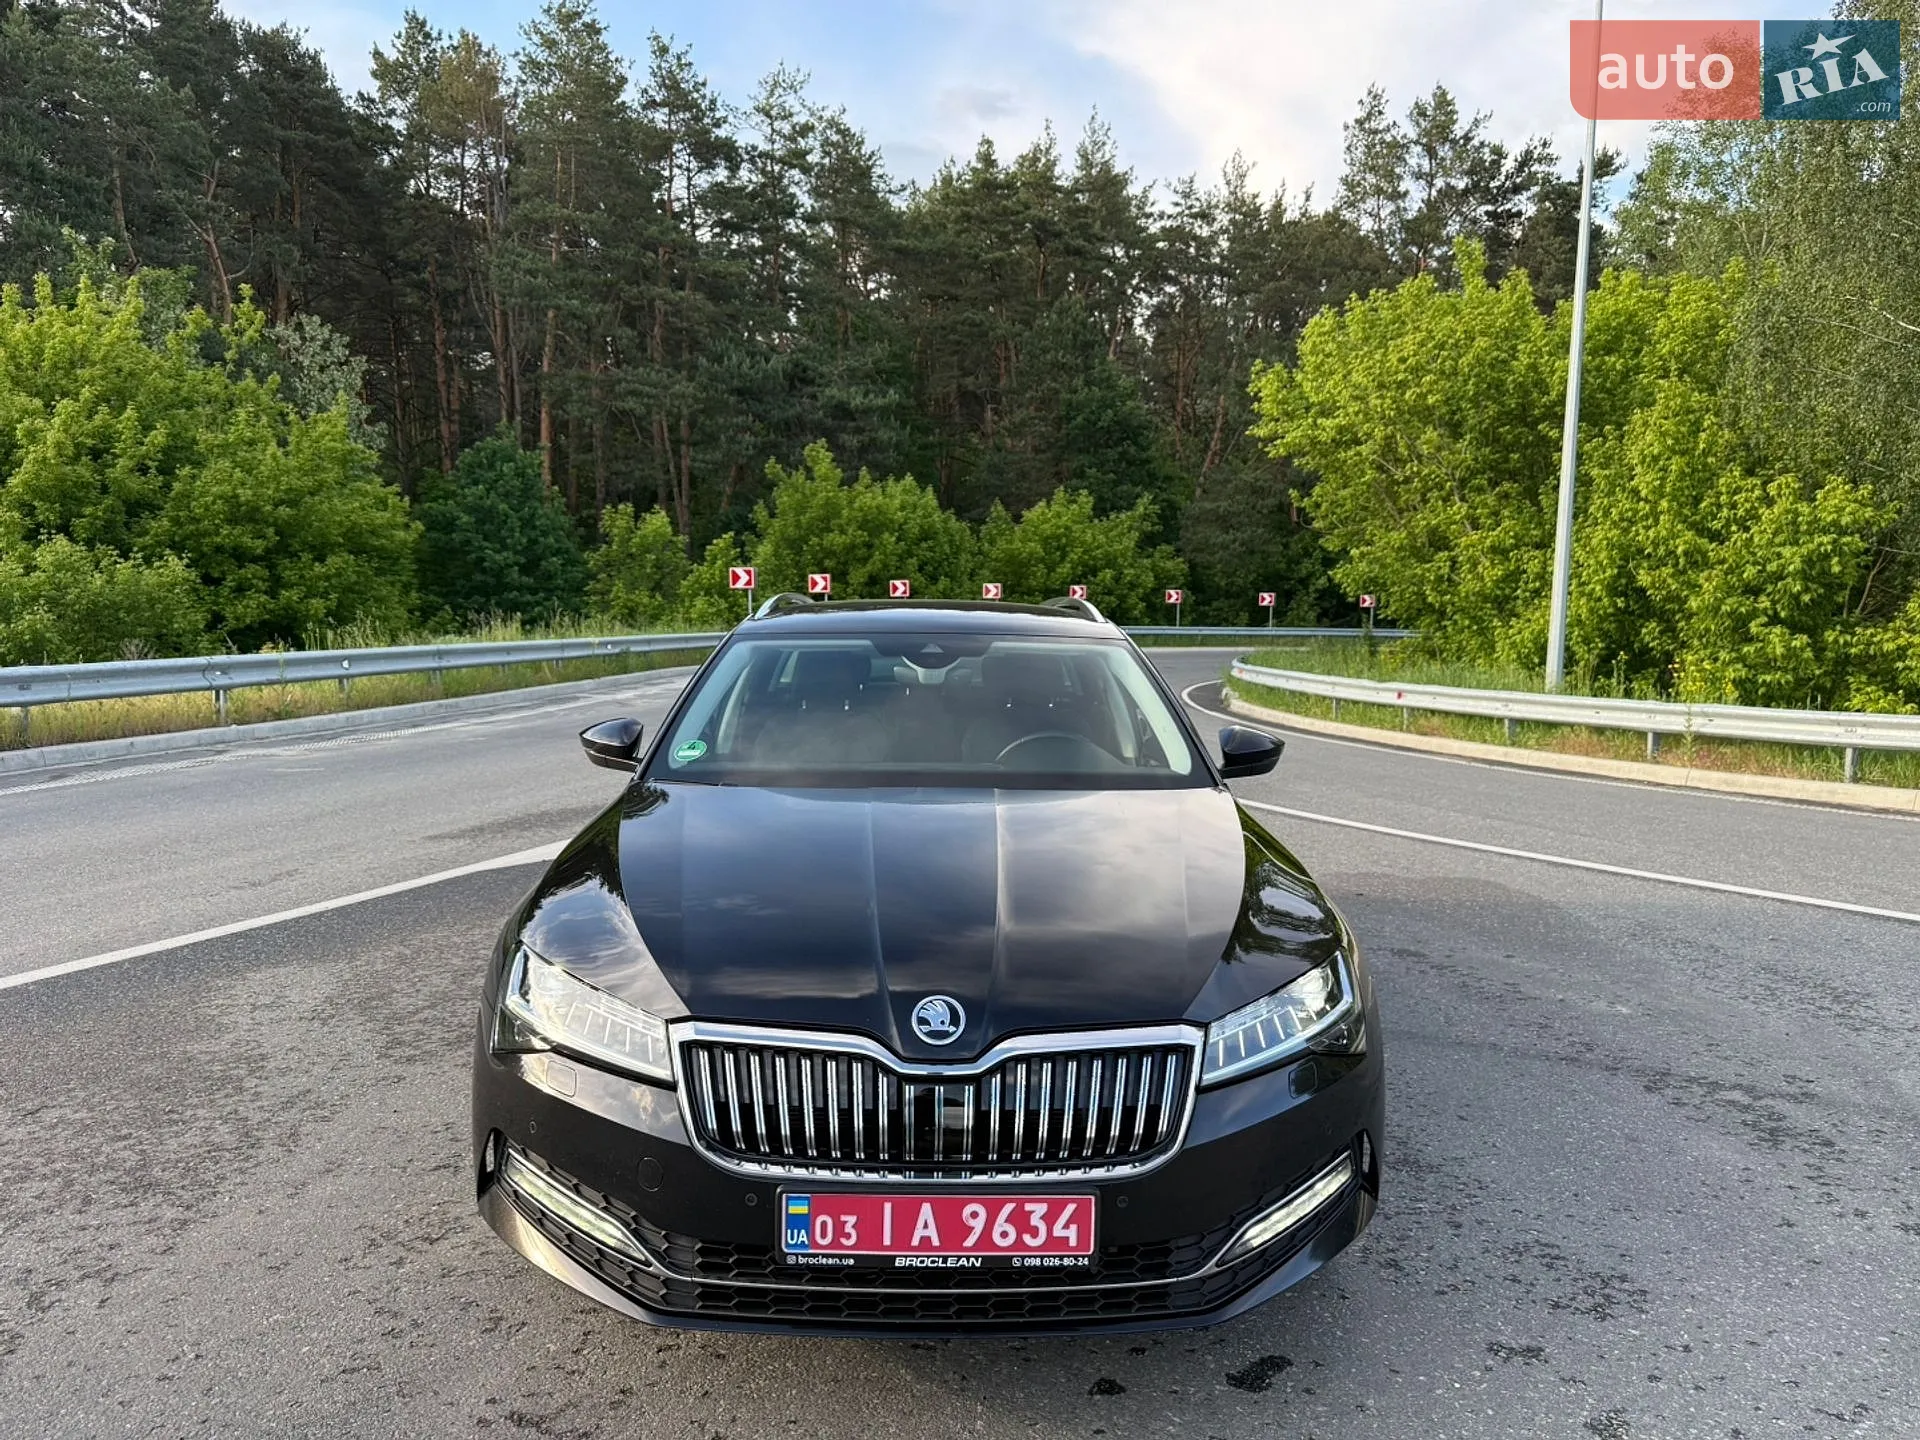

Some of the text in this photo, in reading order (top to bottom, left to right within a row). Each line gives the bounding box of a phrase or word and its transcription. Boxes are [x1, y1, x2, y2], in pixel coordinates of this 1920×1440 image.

[814, 1214, 858, 1246] 03
[962, 1202, 1078, 1247] 9634
[787, 1229, 809, 1245] UA
[798, 1255, 855, 1265] broclean.ua
[895, 1257, 982, 1267] BROCLEAN
[1024, 1257, 1041, 1266] 098
